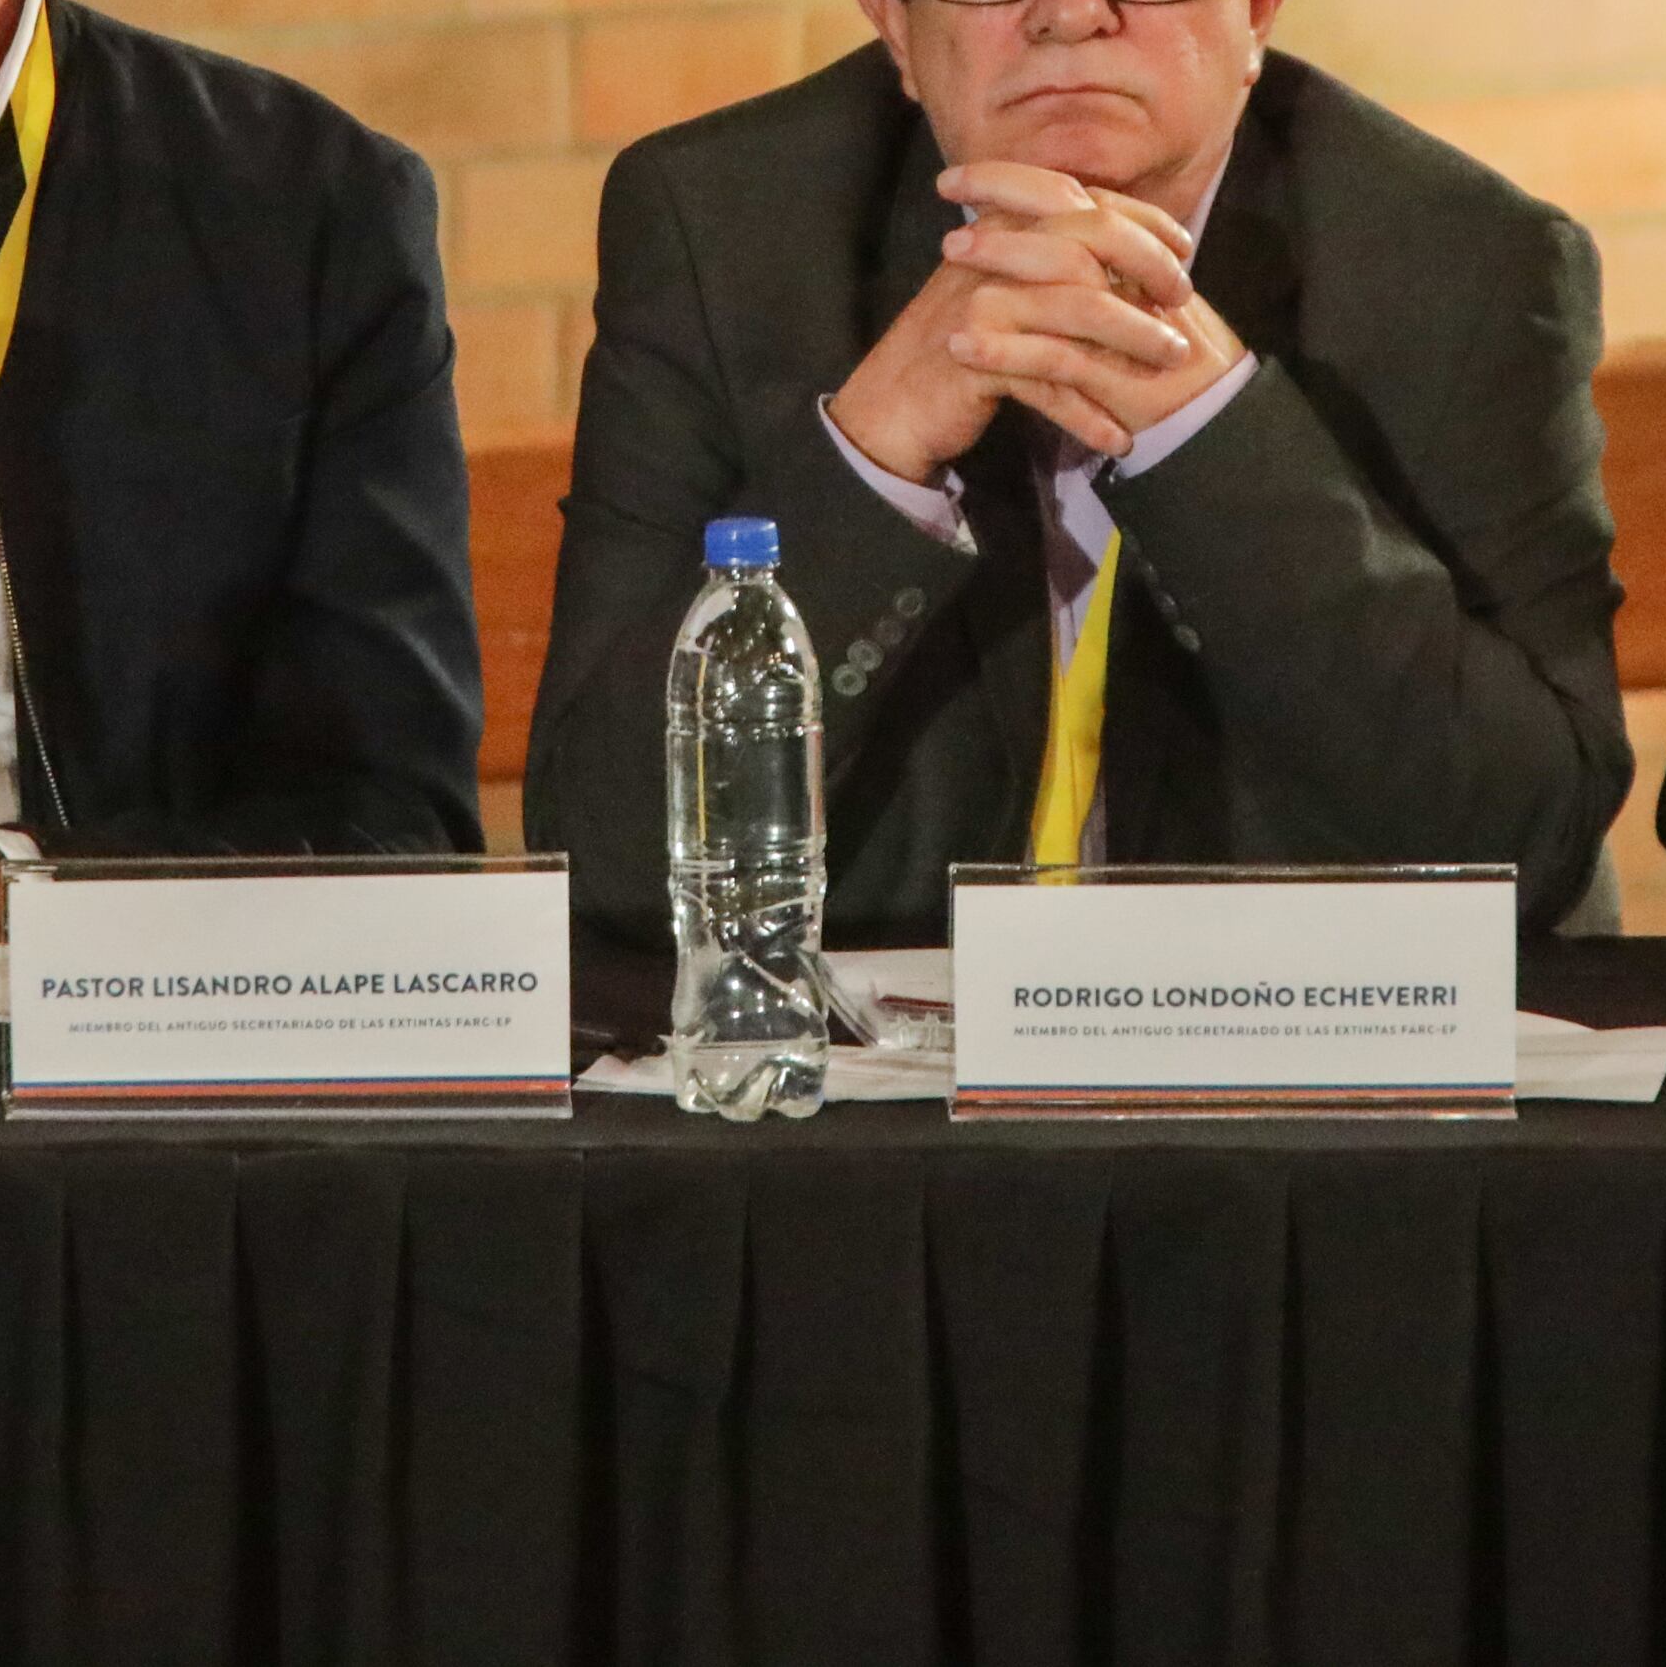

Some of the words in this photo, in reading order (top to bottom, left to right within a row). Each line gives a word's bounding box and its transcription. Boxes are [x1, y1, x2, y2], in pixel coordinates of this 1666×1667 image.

[41, 976, 145, 999] PASTOR
[152, 974, 293, 998] LISANDRO
[299, 973, 385, 995] ALAPE
[393, 972, 539, 994] LASCARRO
[1013, 987, 1145, 1008] RODRIGO
[1152, 982, 1296, 1008] LONDOÑO
[1303, 985, 1457, 1008] ECHEVERRI
[68, 1021, 134, 1033] MIEMBRO
[137, 1020, 161, 1033] DEL
[166, 1020, 228, 1032] ANTIGUO
[231, 1018, 335, 1031] SECRETARIADO
[338, 1018, 356, 1030] DE
[360, 1018, 385, 1030] LAS
[388, 1017, 452, 1029] EXTINTAS
[1013, 1025, 1079, 1037] MIEMBRO
[1082, 1025, 1108, 1037] DEL
[1111, 1025, 1174, 1037] ANTIGUO
[1177, 1025, 1280, 1037] SECRETARIADO
[1284, 1025, 1302, 1037] DE
[1306, 1025, 1330, 1036] LAS
[1334, 1025, 1397, 1036] EXTINTAS
